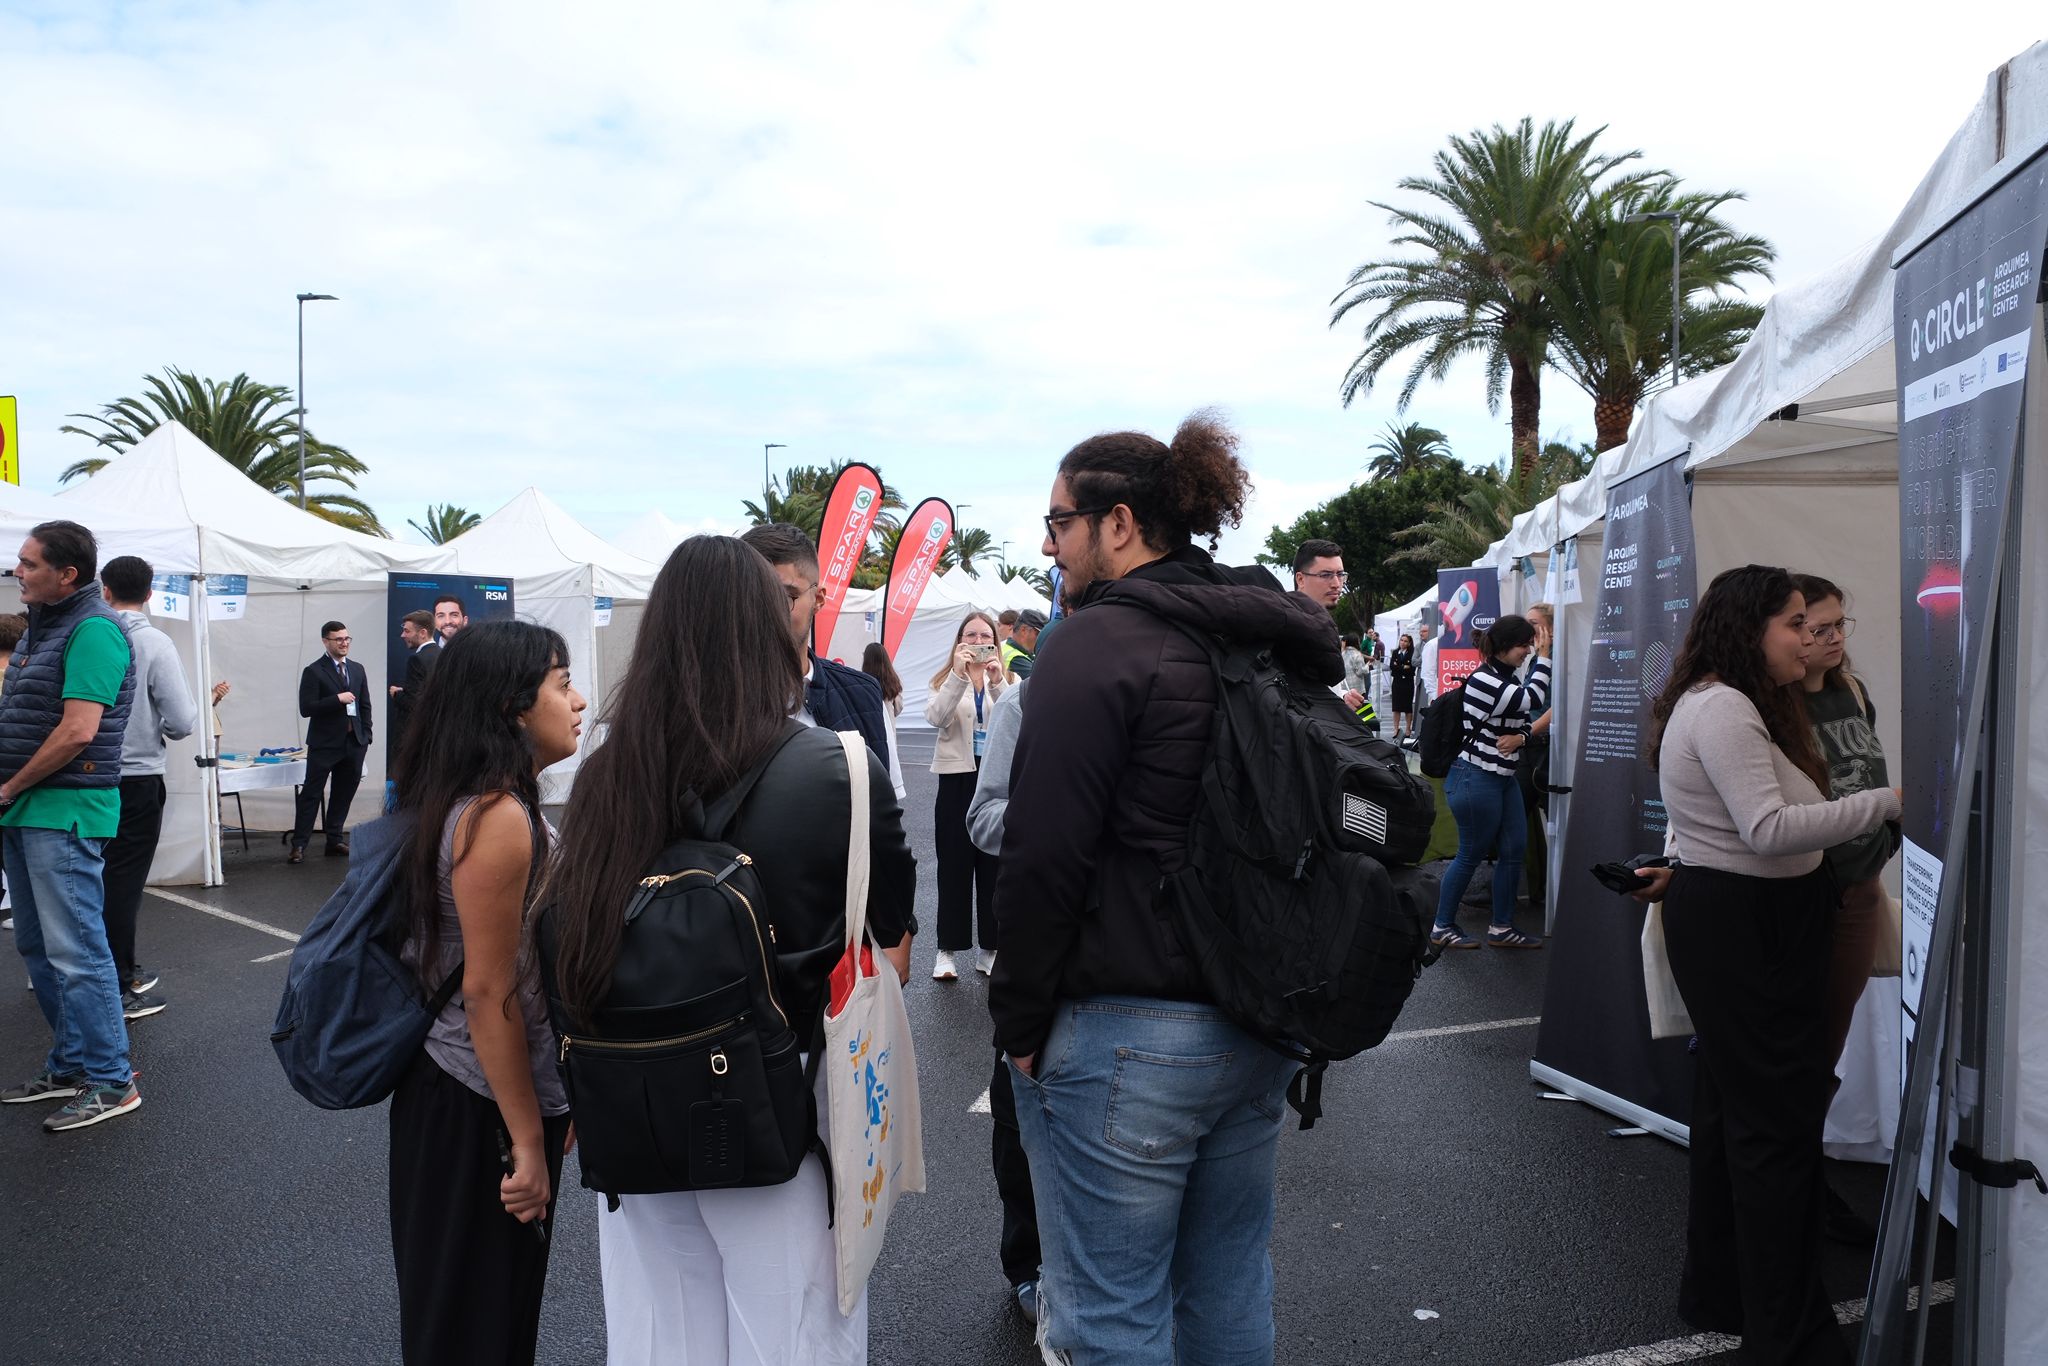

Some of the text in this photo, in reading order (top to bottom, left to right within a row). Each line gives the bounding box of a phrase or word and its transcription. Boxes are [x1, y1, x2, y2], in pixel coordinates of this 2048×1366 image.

[1994, 250, 2030, 281] ARQUIMEA
[1993, 269, 2029, 299] RESEARCH
[1992, 294, 2019, 318] CENTER
[1612, 494, 1649, 521] ARQUIMEA
[830, 511, 862, 578] SPAR
[1607, 543, 1638, 561] ARQUIMEA
[901, 540, 935, 595] SPAR
[1605, 557, 1638, 575] RESEARCH
[1656, 555, 1682, 570] QUANTUM
[1604, 574, 1632, 589] CENTER
[163, 595, 177, 612] 31
[485, 591, 507, 601] RSM
[1664, 598, 1689, 612] ROBOTICS
[1613, 605, 1622, 615] AI
[1475, 617, 1495, 625] auren
[1643, 810, 1669, 820] ARQUIME
[1906, 856, 1933, 883] TRANSFERRING
[1906, 870, 1933, 898] TECHNOLOGIES
[1906, 884, 1937, 913] IMPROVE SOCIET
[1906, 899, 1921, 918] QUALITY
[1921, 911, 1927, 921] OF
